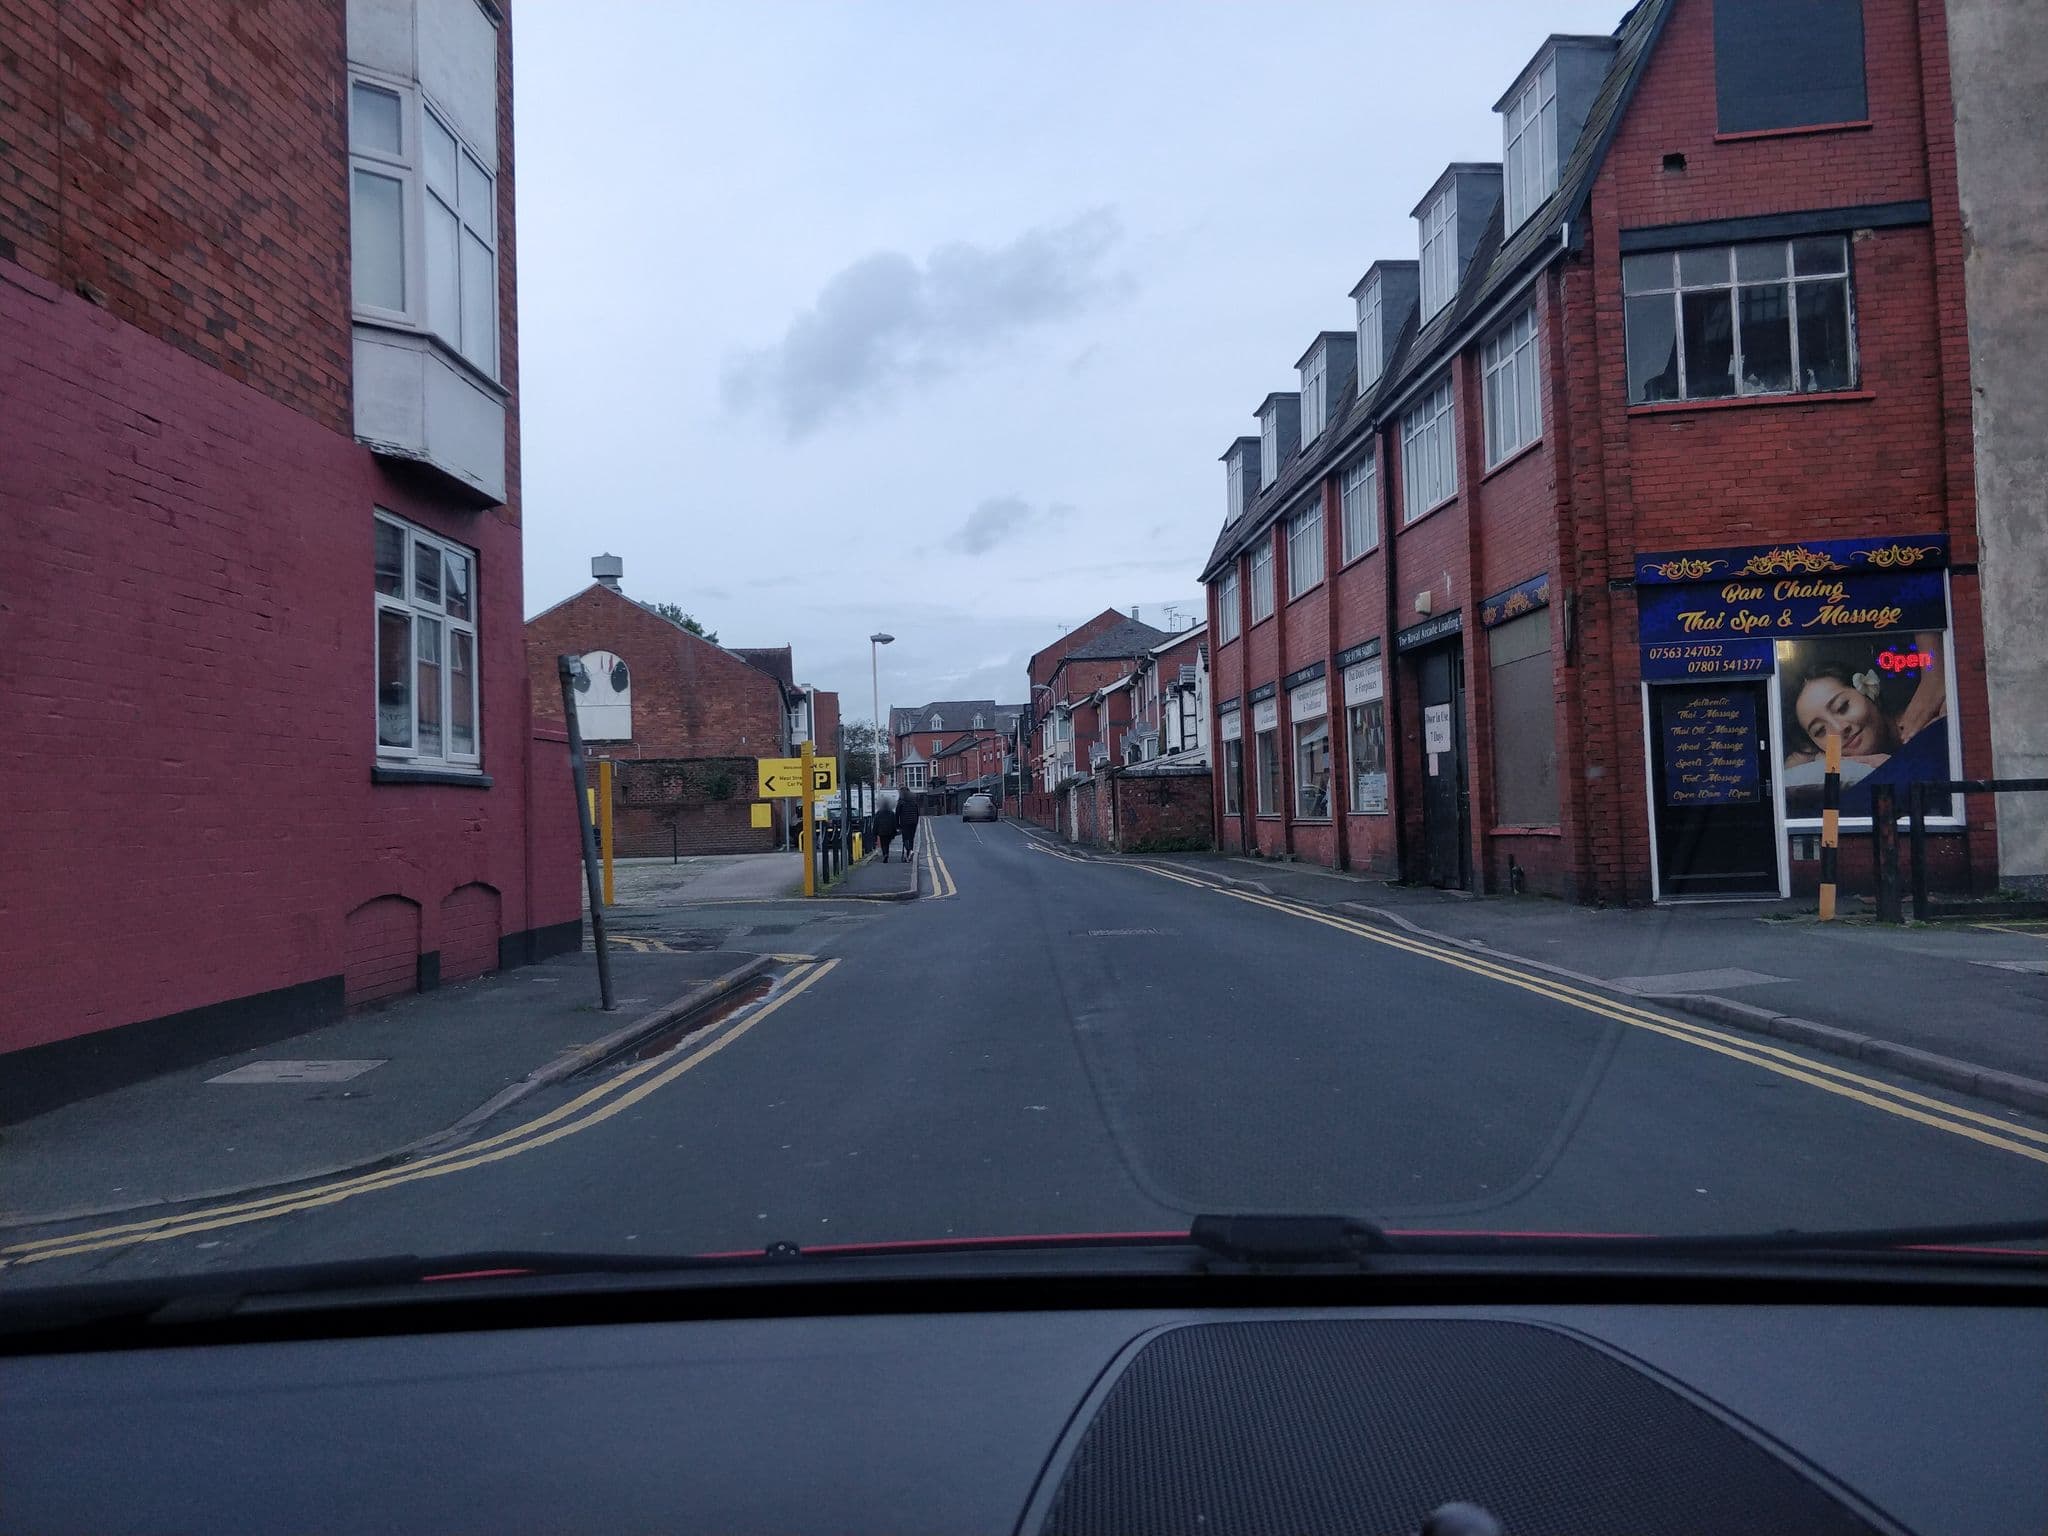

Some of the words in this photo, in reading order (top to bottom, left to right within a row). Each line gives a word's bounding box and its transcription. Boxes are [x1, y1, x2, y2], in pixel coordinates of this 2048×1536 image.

[1721, 583, 1764, 603] Ban
[1773, 579, 1850, 603] Chaing
[1677, 611, 1724, 633] Thai
[1730, 609, 1772, 632] Spa
[1777, 608, 1793, 625] &
[1802, 605, 1902, 628] Massage
[1421, 624, 1438, 639] Arcade
[1438, 617, 1459, 632] Loading
[1649, 647, 1682, 660] 07563
[1684, 645, 1723, 658] 247052
[1687, 661, 1721, 673] 07801
[1721, 658, 1762, 671] 541377
[1878, 651, 1932, 671] Open
[1687, 697, 1729, 708] Authentic
[1678, 709, 1697, 719] Thai
[1700, 709, 1740, 719] Massage
[1671, 726, 1690, 736] Thai
[1691, 725, 1707, 735] Oil
[1709, 725, 1749, 735] Massage
[1677, 743, 1700, 752] Head
[1704, 741, 1744, 752] Massage
[1675, 758, 1702, 769] Sports
[1706, 757, 1745, 768] Massage
[1682, 774, 1702, 783] Foot
[1702, 773, 1742, 784] Massage
[1673, 790, 1696, 801] Open
